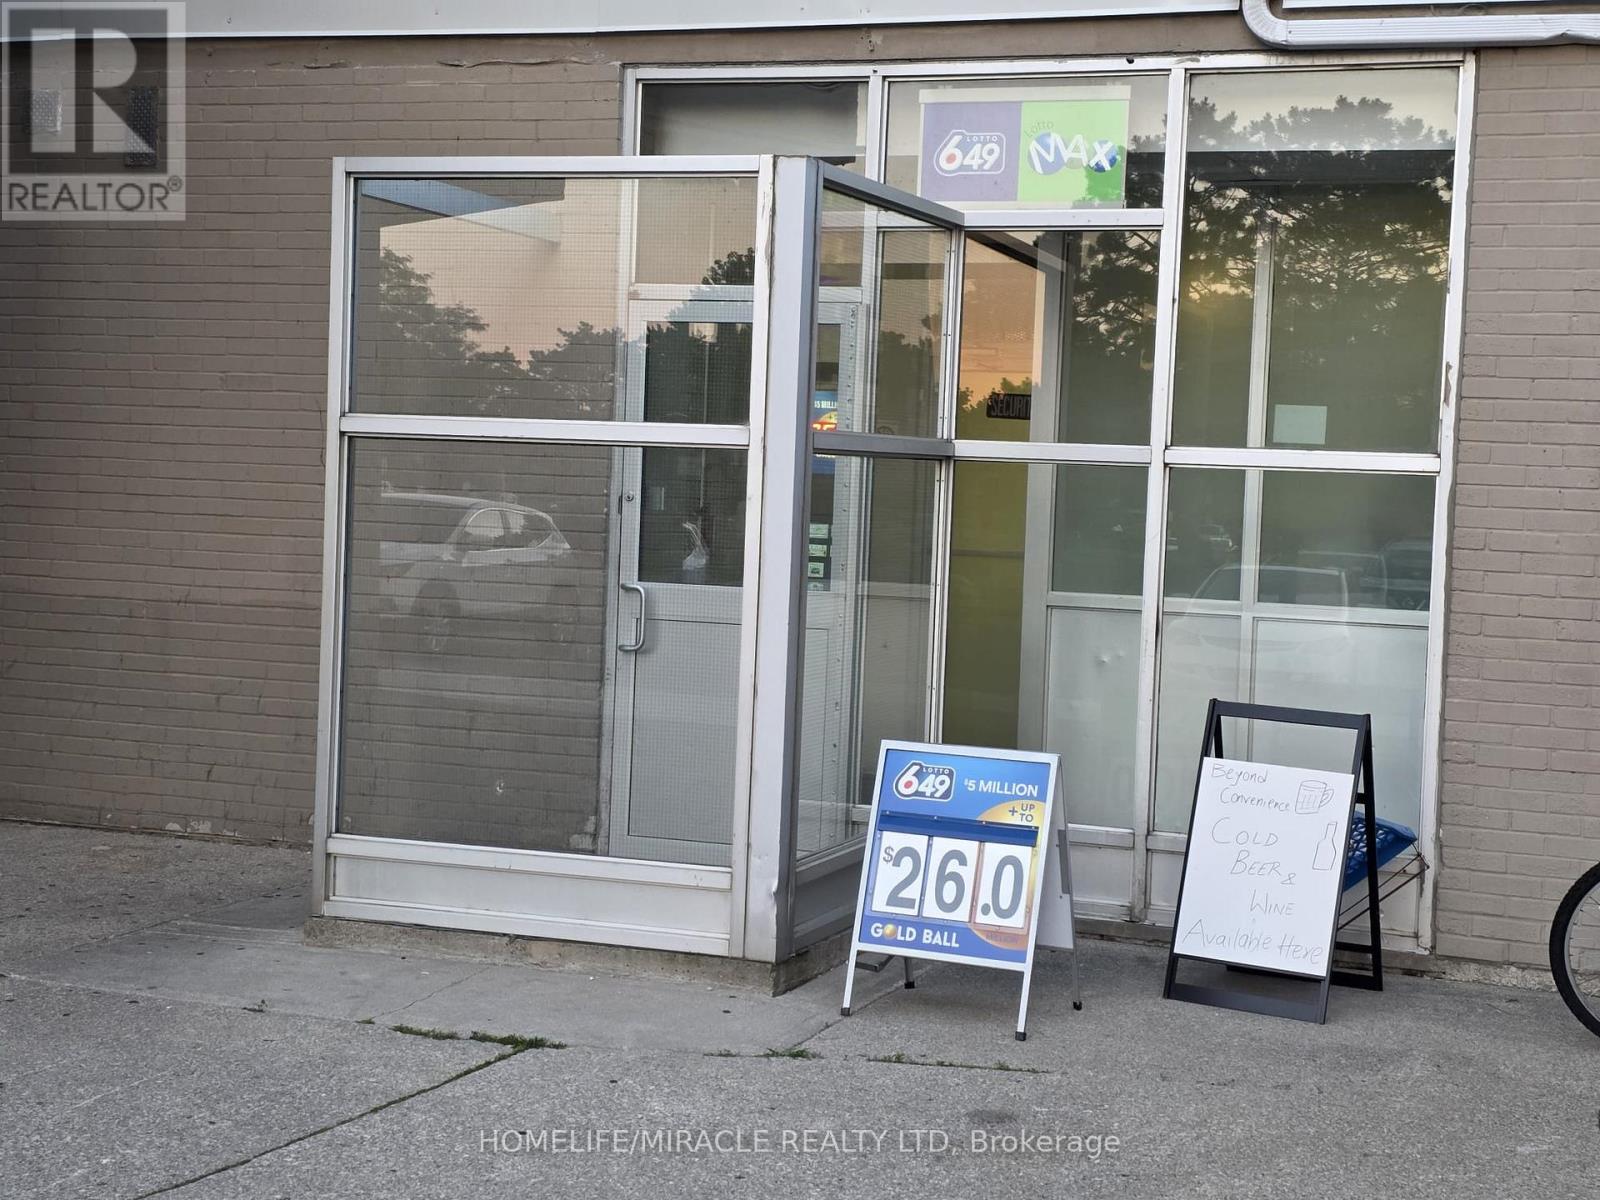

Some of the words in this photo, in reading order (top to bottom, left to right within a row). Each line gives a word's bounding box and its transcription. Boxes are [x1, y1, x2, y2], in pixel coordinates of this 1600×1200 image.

[939, 135, 1000, 170] 649
[1029, 132, 1114, 174] MAX
[898, 765, 951, 798] 649
[1211, 763, 1269, 786] Beyond
[979, 779, 1038, 798] MILLION
[1019, 813, 1034, 823] TO
[1021, 803, 1035, 812] UP
[1211, 817, 1279, 847] COLD
[1230, 850, 1281, 876] BEER
[1249, 889, 1296, 916] WINE
[922, 929, 960, 948] BALL
[1182, 918, 1272, 952] Available
[1278, 933, 1324, 964] Here
